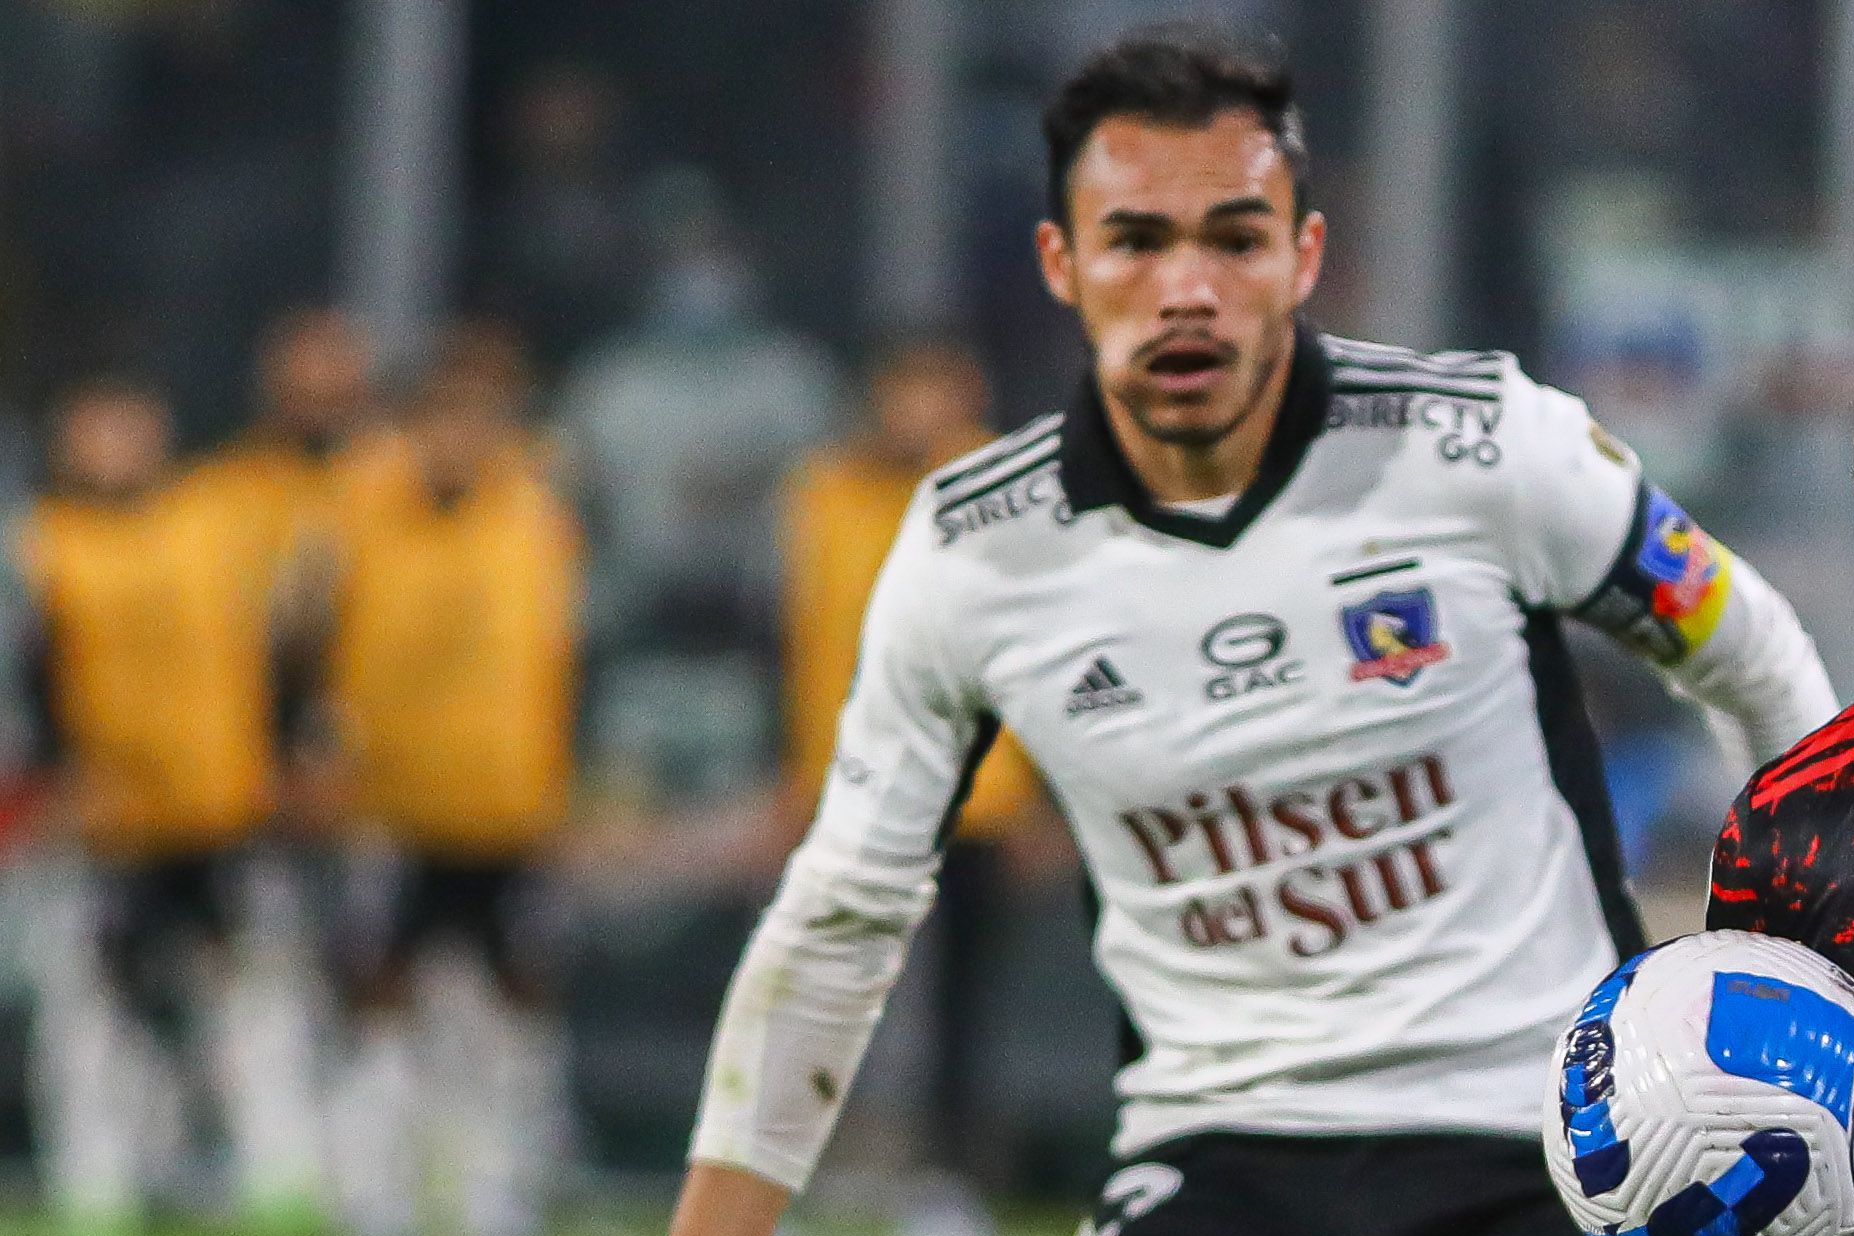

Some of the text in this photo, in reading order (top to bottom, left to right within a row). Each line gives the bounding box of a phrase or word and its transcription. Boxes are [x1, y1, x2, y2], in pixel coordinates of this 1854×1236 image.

[1327, 395, 1503, 435] DIRECTV
[1438, 434, 1503, 469] GO
[1205, 662, 1305, 702] GAC
[1117, 753, 1455, 884] Pilsen
[1180, 828, 1454, 956] del Sur
